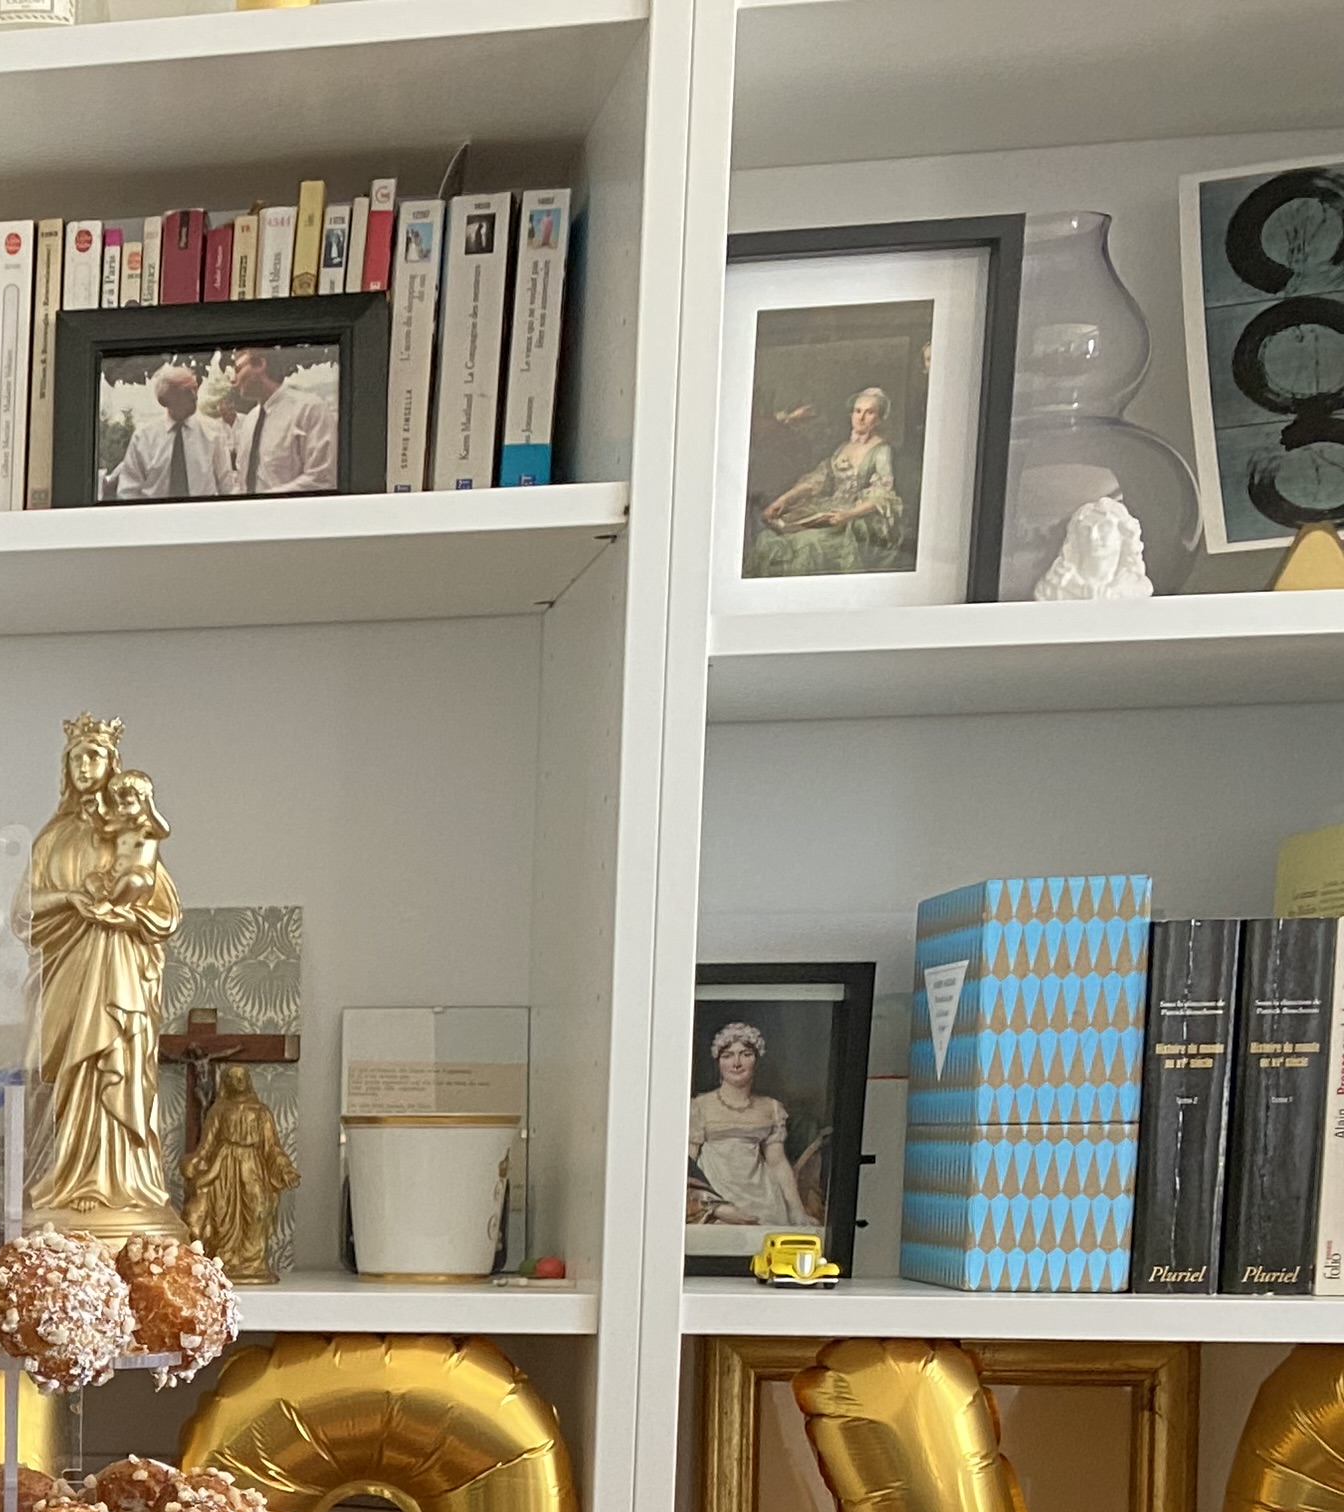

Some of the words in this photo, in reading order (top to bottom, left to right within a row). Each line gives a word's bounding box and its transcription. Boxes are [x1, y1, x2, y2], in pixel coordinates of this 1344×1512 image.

[399, 437, 410, 470] SOPHIE
[1147, 1264, 1207, 1286] Pluriel
[1241, 1264, 1300, 1286] Pluriel
